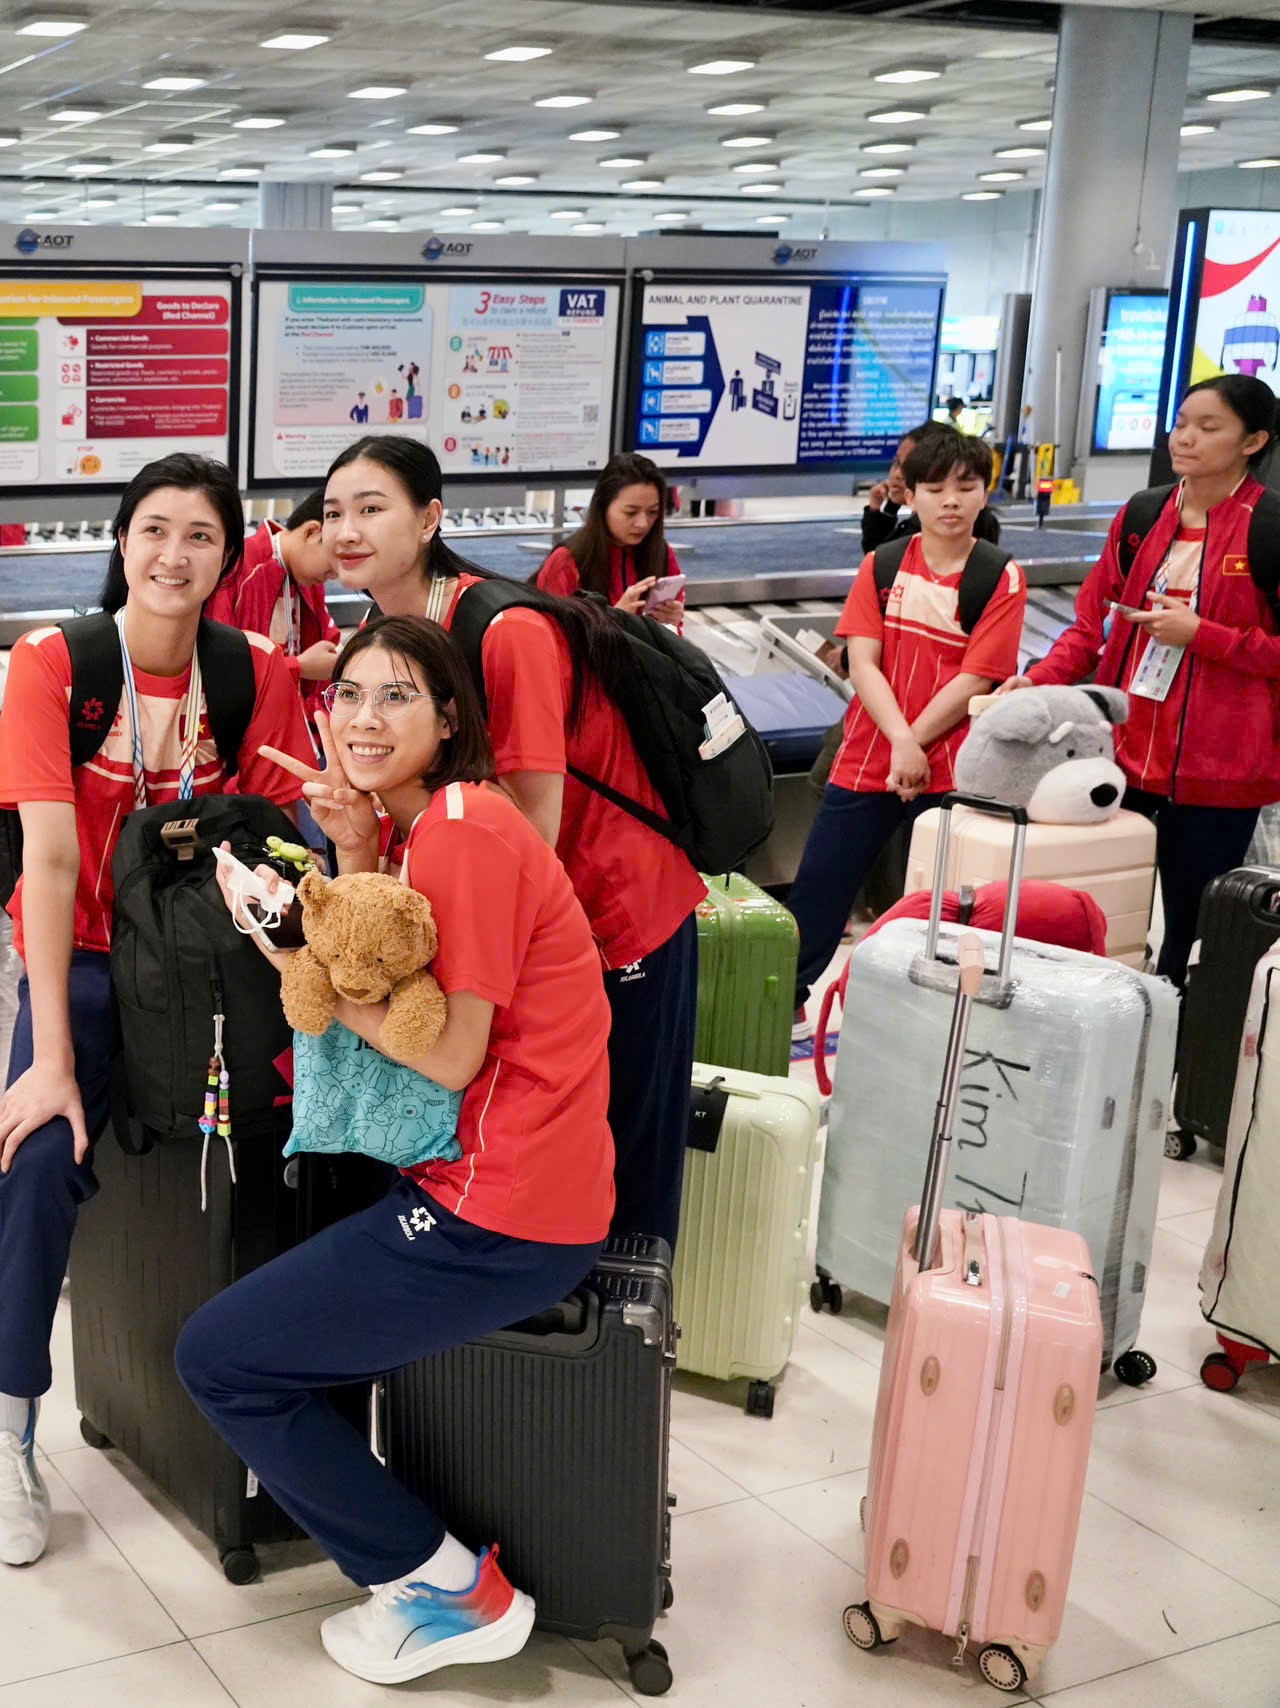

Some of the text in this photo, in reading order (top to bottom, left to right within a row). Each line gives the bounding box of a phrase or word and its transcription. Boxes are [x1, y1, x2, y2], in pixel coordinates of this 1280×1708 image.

[42, 235, 74, 246] AOT
[446, 243, 474, 253] AOT
[156, 302, 220, 310] Goods to Declare
[474, 291, 546, 315] 3 Easy Steps
[566, 294, 597, 308] VAT
[648, 295, 803, 306] ANIMAL AND PLANT QUARANTINE
[958, 1049, 1031, 1150] Kim
